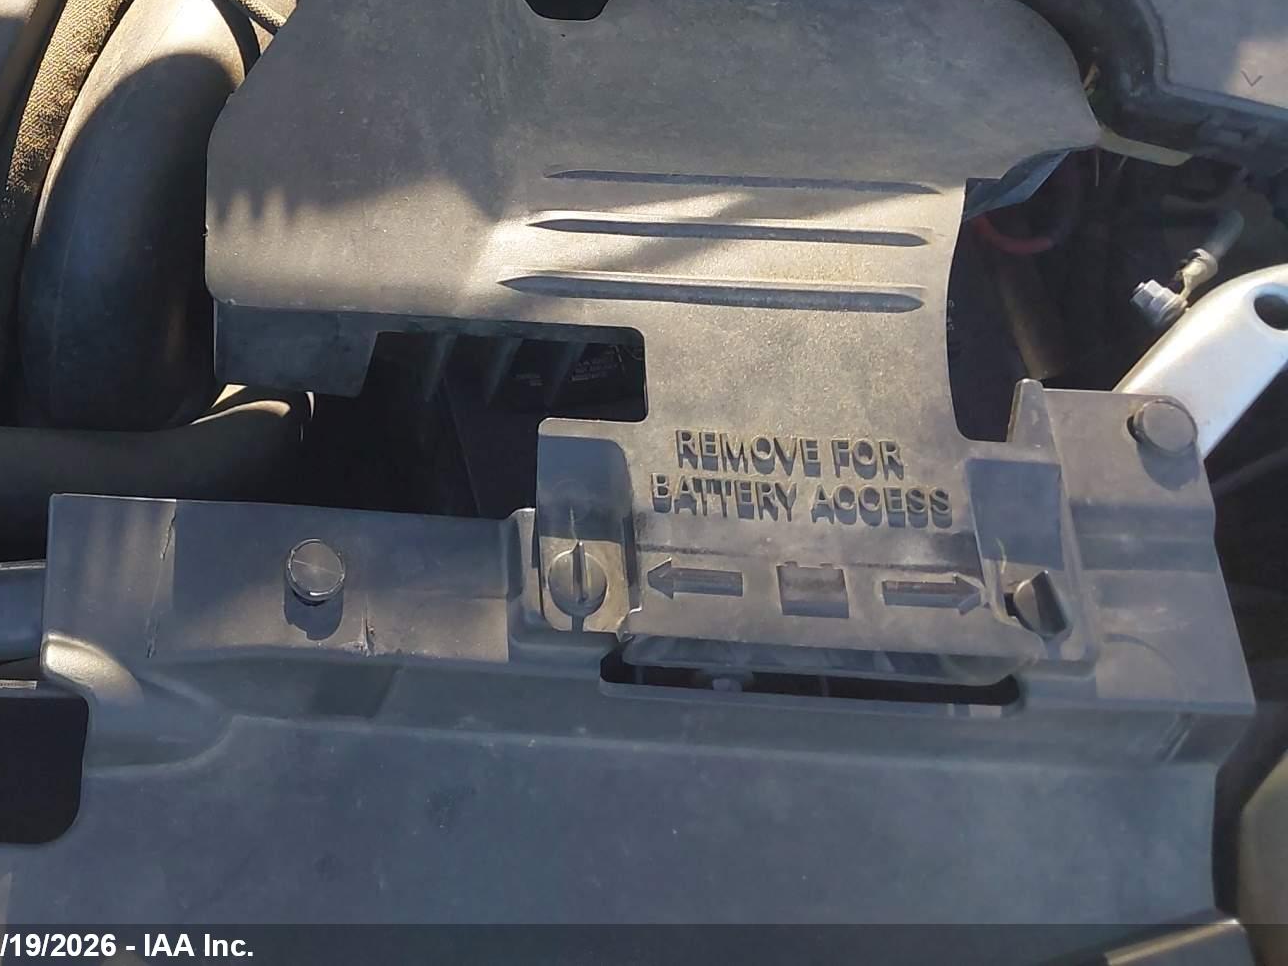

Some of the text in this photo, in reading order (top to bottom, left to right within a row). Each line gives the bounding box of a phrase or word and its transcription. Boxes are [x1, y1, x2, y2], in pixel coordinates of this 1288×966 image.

[676, 429, 905, 480] REMOVE FOR
[651, 472, 953, 528] BATTERY ACCESS
